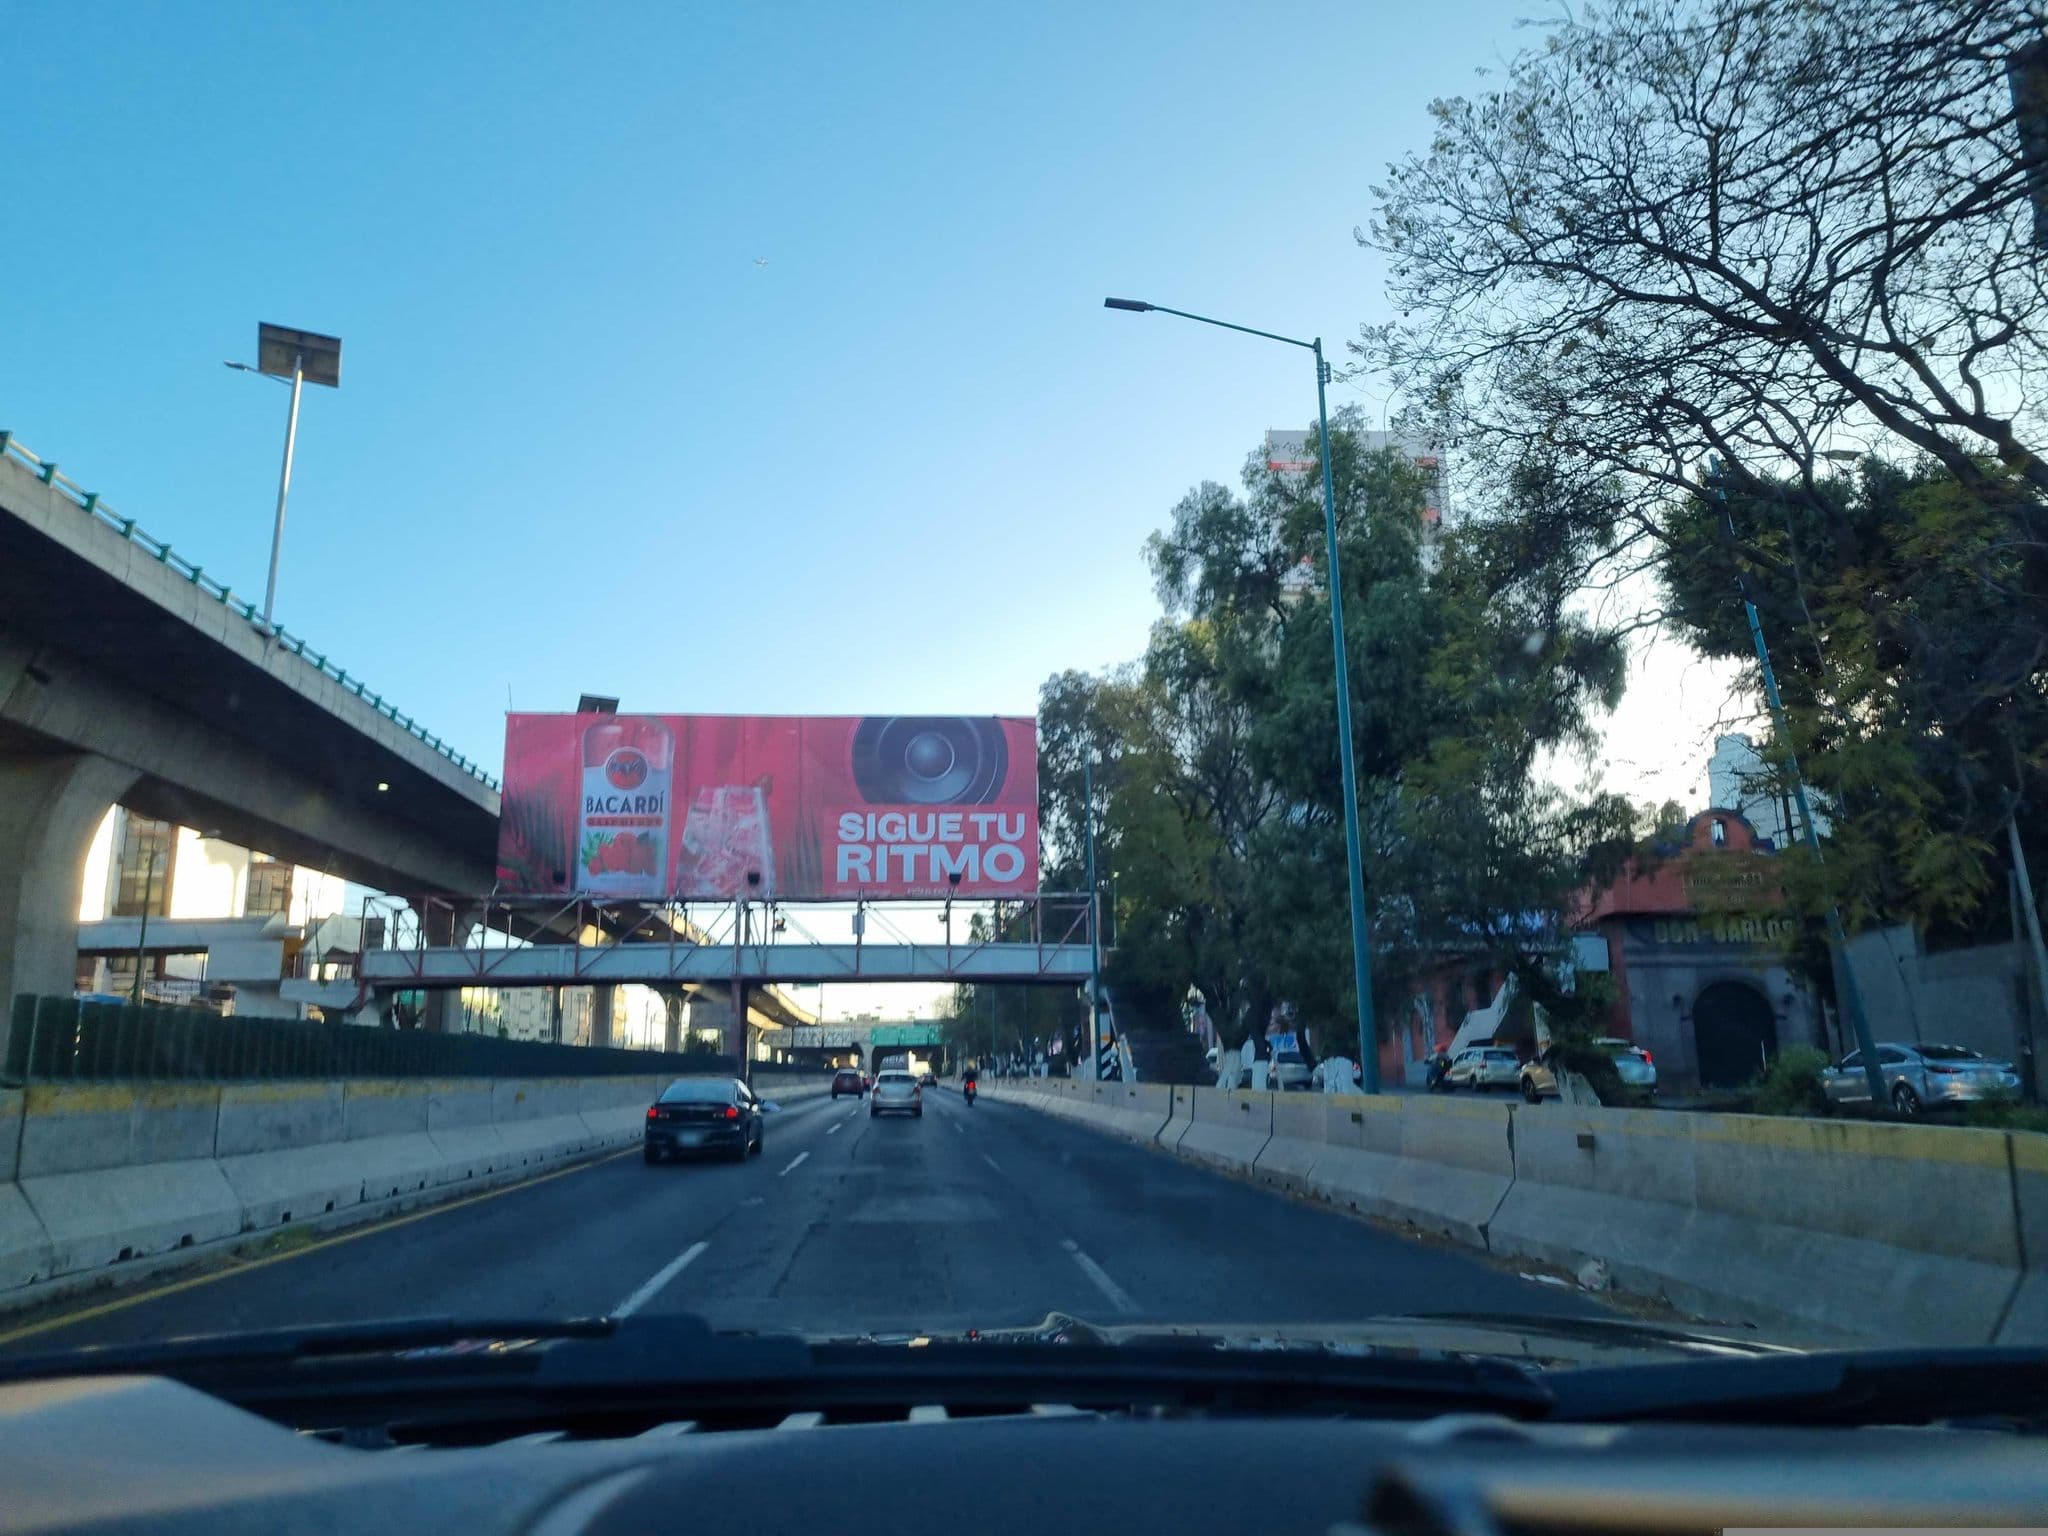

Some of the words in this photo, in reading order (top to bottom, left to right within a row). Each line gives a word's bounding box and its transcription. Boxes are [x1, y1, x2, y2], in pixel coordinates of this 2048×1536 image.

[586, 790, 664, 814] BACARDÍ
[838, 812, 964, 842] SIGUE
[969, 813, 1026, 842] TU
[836, 843, 1026, 883] RITMO
